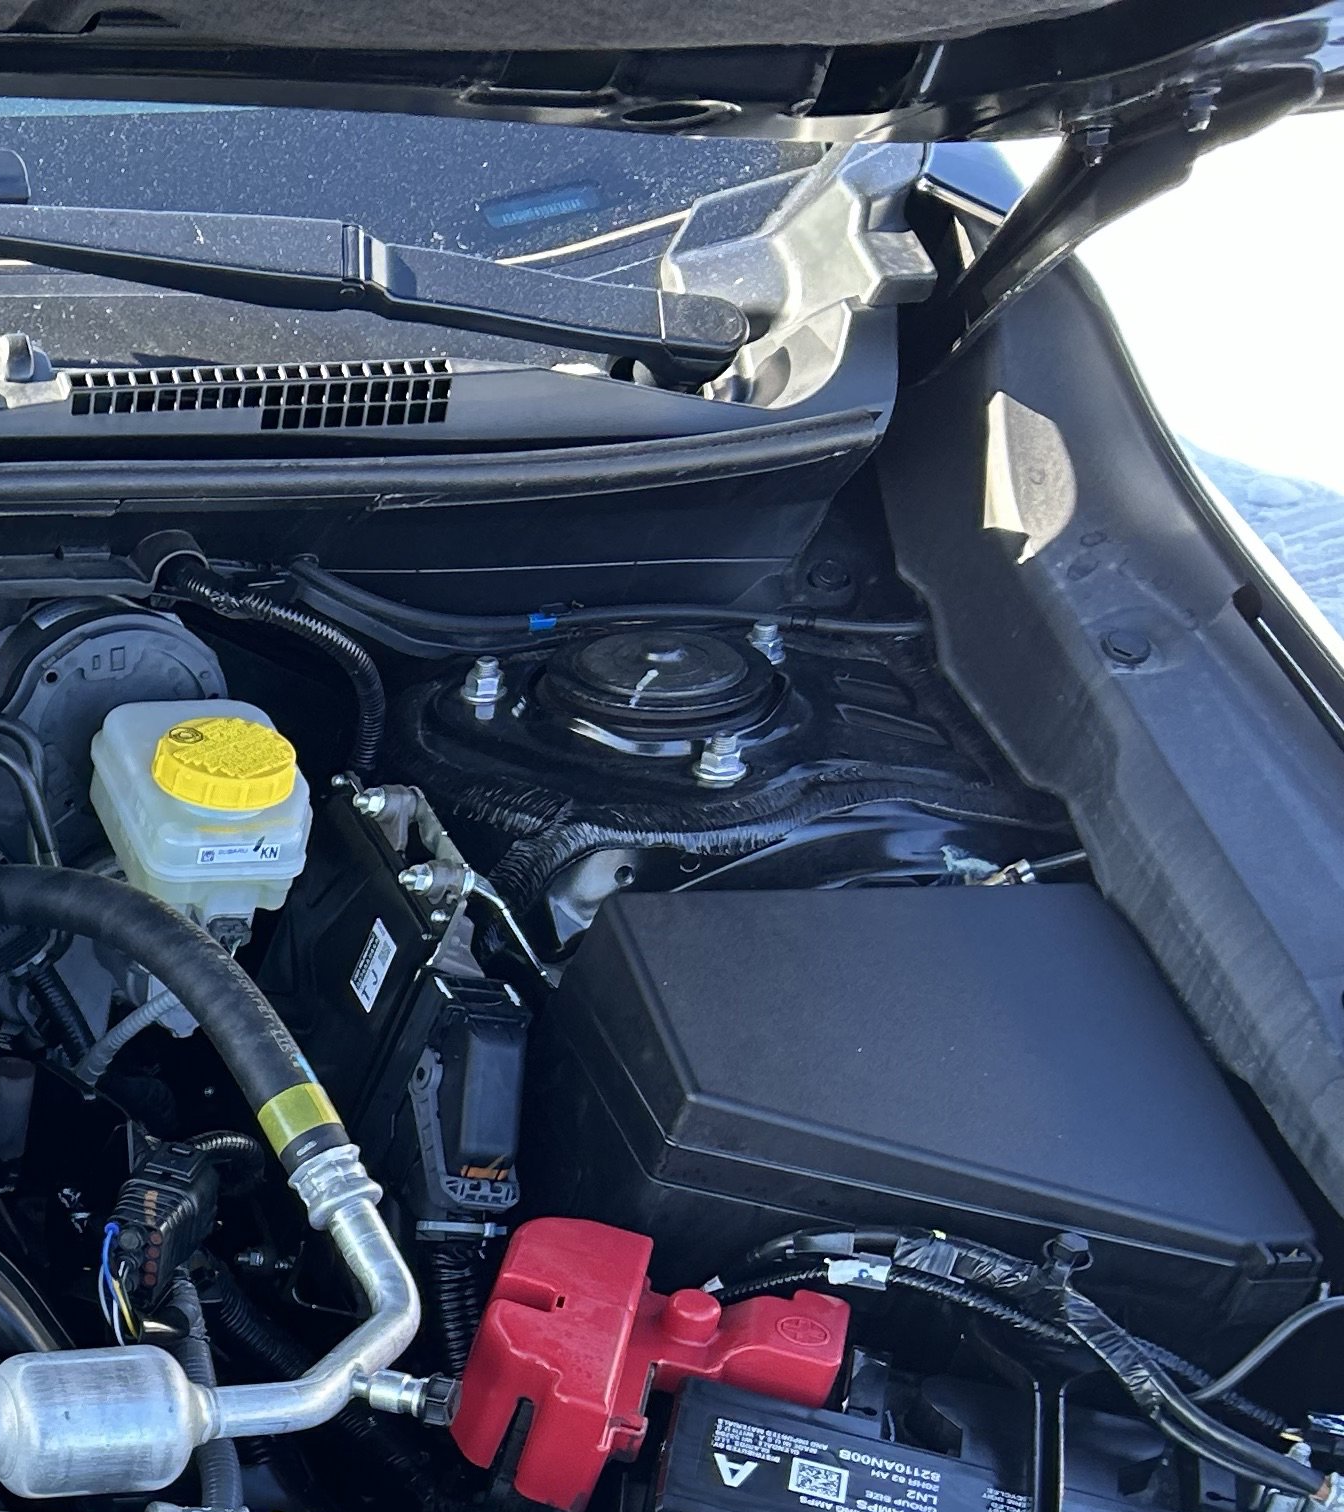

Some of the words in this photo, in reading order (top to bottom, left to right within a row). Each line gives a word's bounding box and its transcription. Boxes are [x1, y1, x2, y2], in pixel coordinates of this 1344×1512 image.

[260, 846, 279, 859] KN
[839, 1449, 941, 1482] 82110AN00B
[799, 1496, 833, 1511] AMPS
[906, 1489, 938, 1506] LN2
